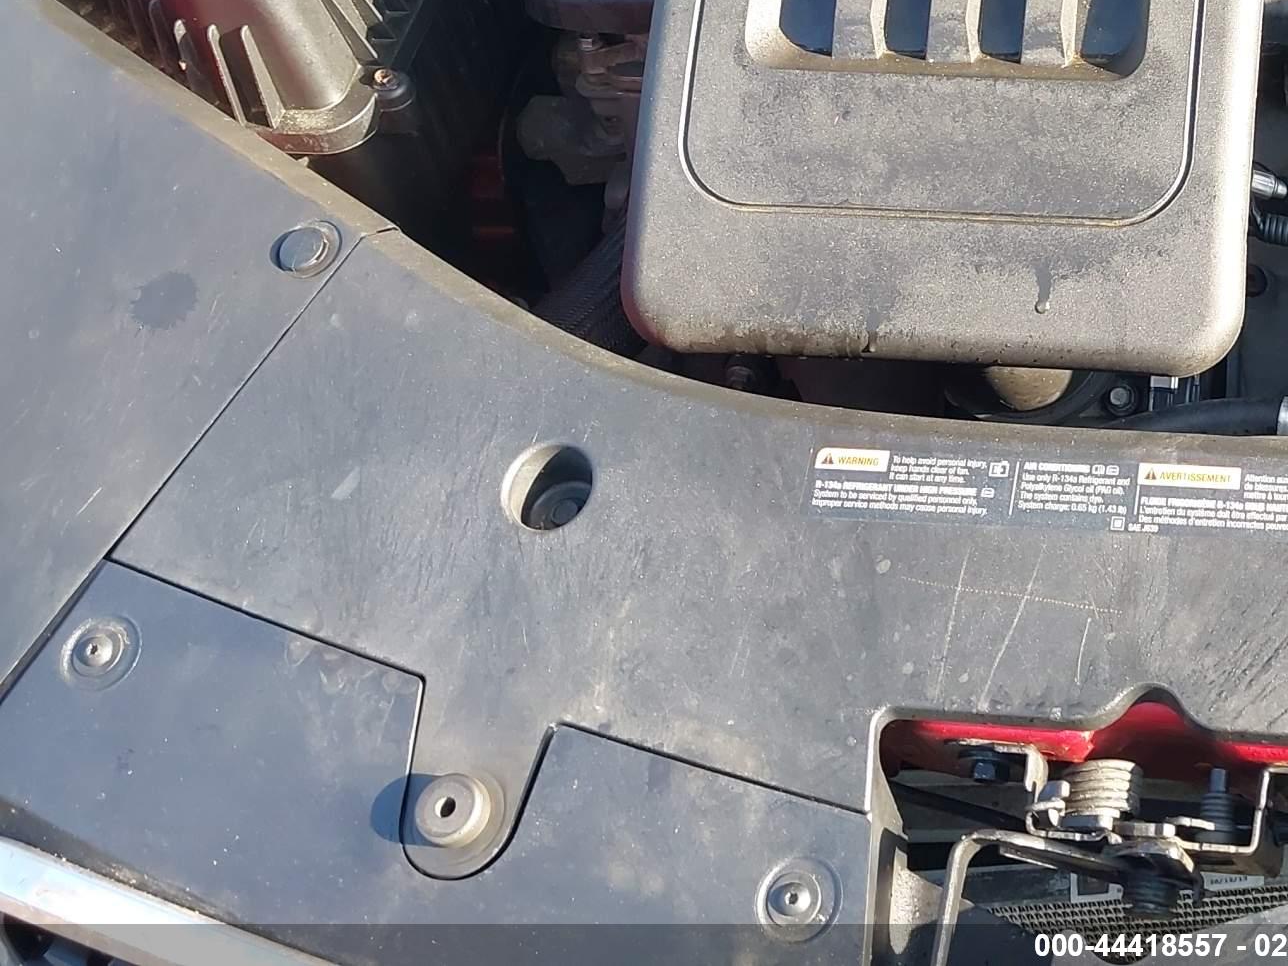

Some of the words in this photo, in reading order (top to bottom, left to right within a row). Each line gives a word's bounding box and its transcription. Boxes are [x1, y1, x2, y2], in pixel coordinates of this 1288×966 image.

[838, 456, 879, 466] WARNING
[902, 457, 916, 466] help
[937, 458, 966, 467] personal
[1022, 473, 1036, 481] Use
[1037, 474, 1051, 483] only
[1052, 475, 1077, 484] R-134a
[1079, 476, 1116, 485] Refrigerant
[1117, 477, 1130, 486] and
[1160, 471, 1232, 483] AVERTISSEMENT
[816, 480, 841, 489] R-134a
[814, 489, 839, 498] System
[840, 490, 847, 498] to
[858, 492, 887, 500] serviced
[888, 493, 897, 501] by
[1020, 491, 1033, 499] The
[1034, 493, 1057, 501] system
[1060, 494, 1088, 502] contains
[812, 498, 842, 508] Improper
[869, 501, 898, 510] methods
[899, 503, 914, 512] may
[937, 505, 966, 514] personal
[1018, 500, 1043, 510] System
[1071, 503, 1087, 511] 0.65
[1088, 504, 1097, 514] kg
